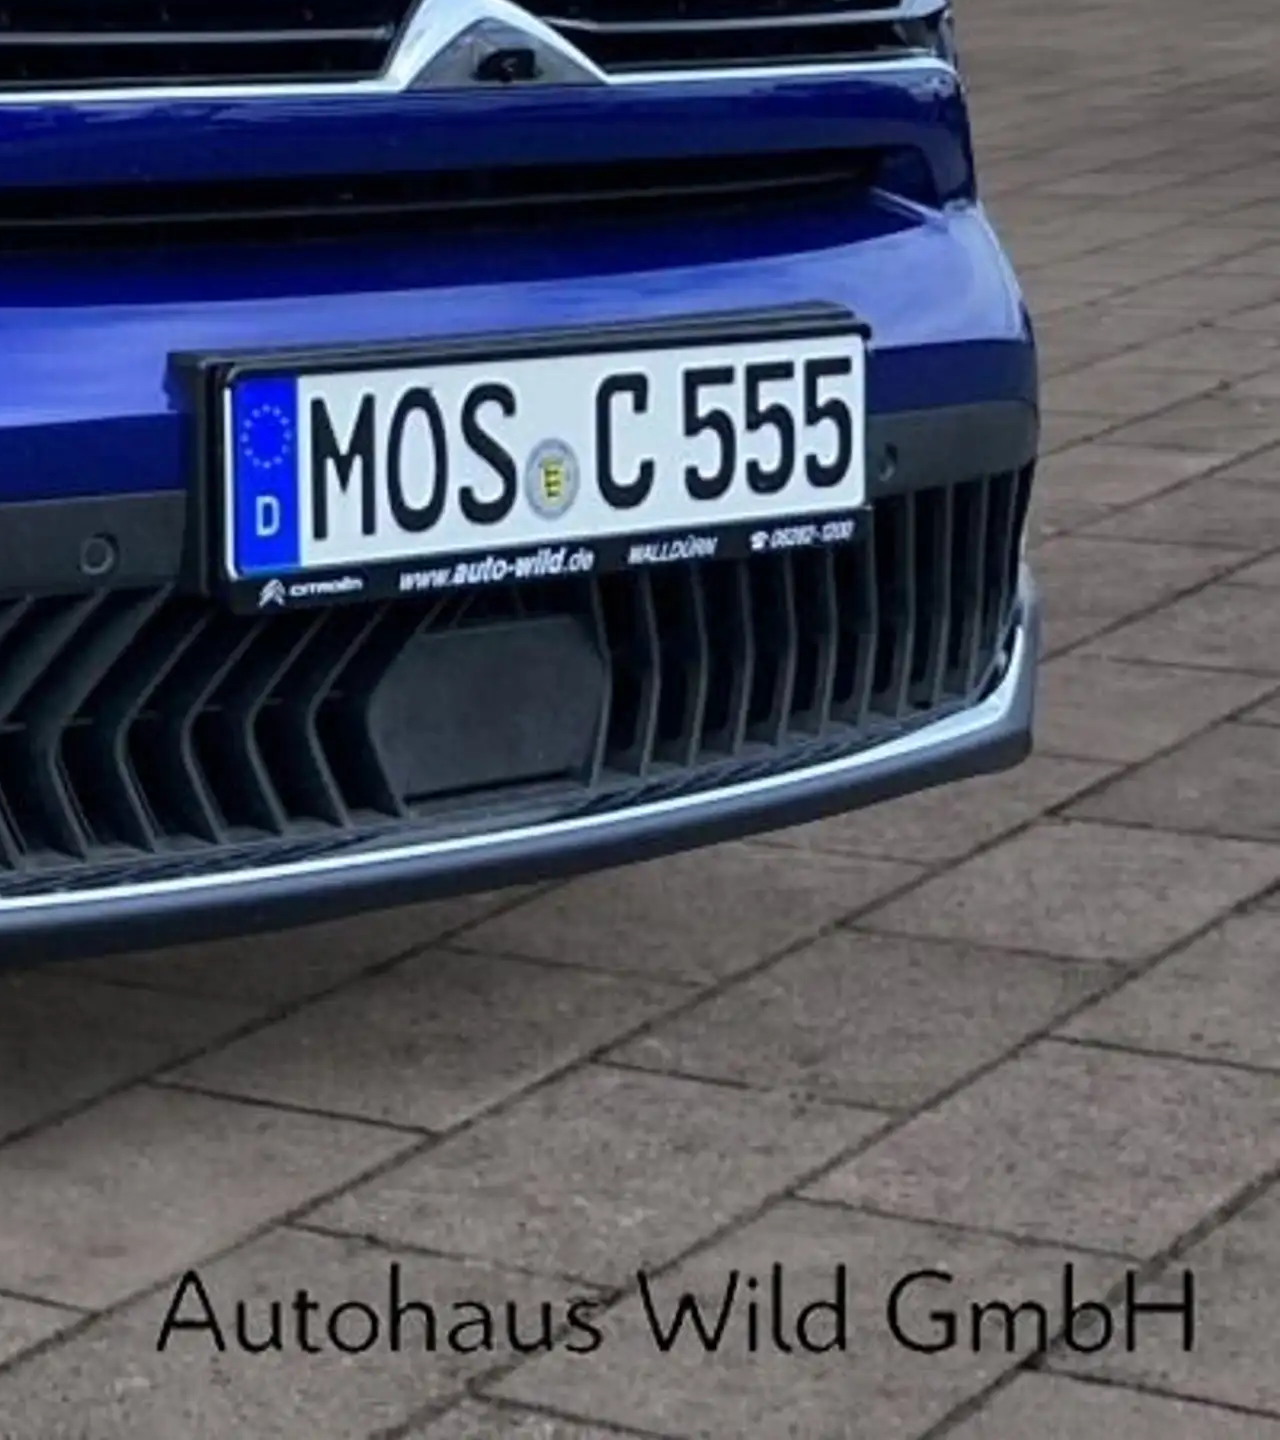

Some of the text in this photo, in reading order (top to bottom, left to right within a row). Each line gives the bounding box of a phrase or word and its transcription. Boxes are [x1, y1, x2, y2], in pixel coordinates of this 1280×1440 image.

[310, 357, 853, 541] MOS C 555
[256, 495, 281, 537] D
[398, 544, 595, 592] www.auto-wild.de
